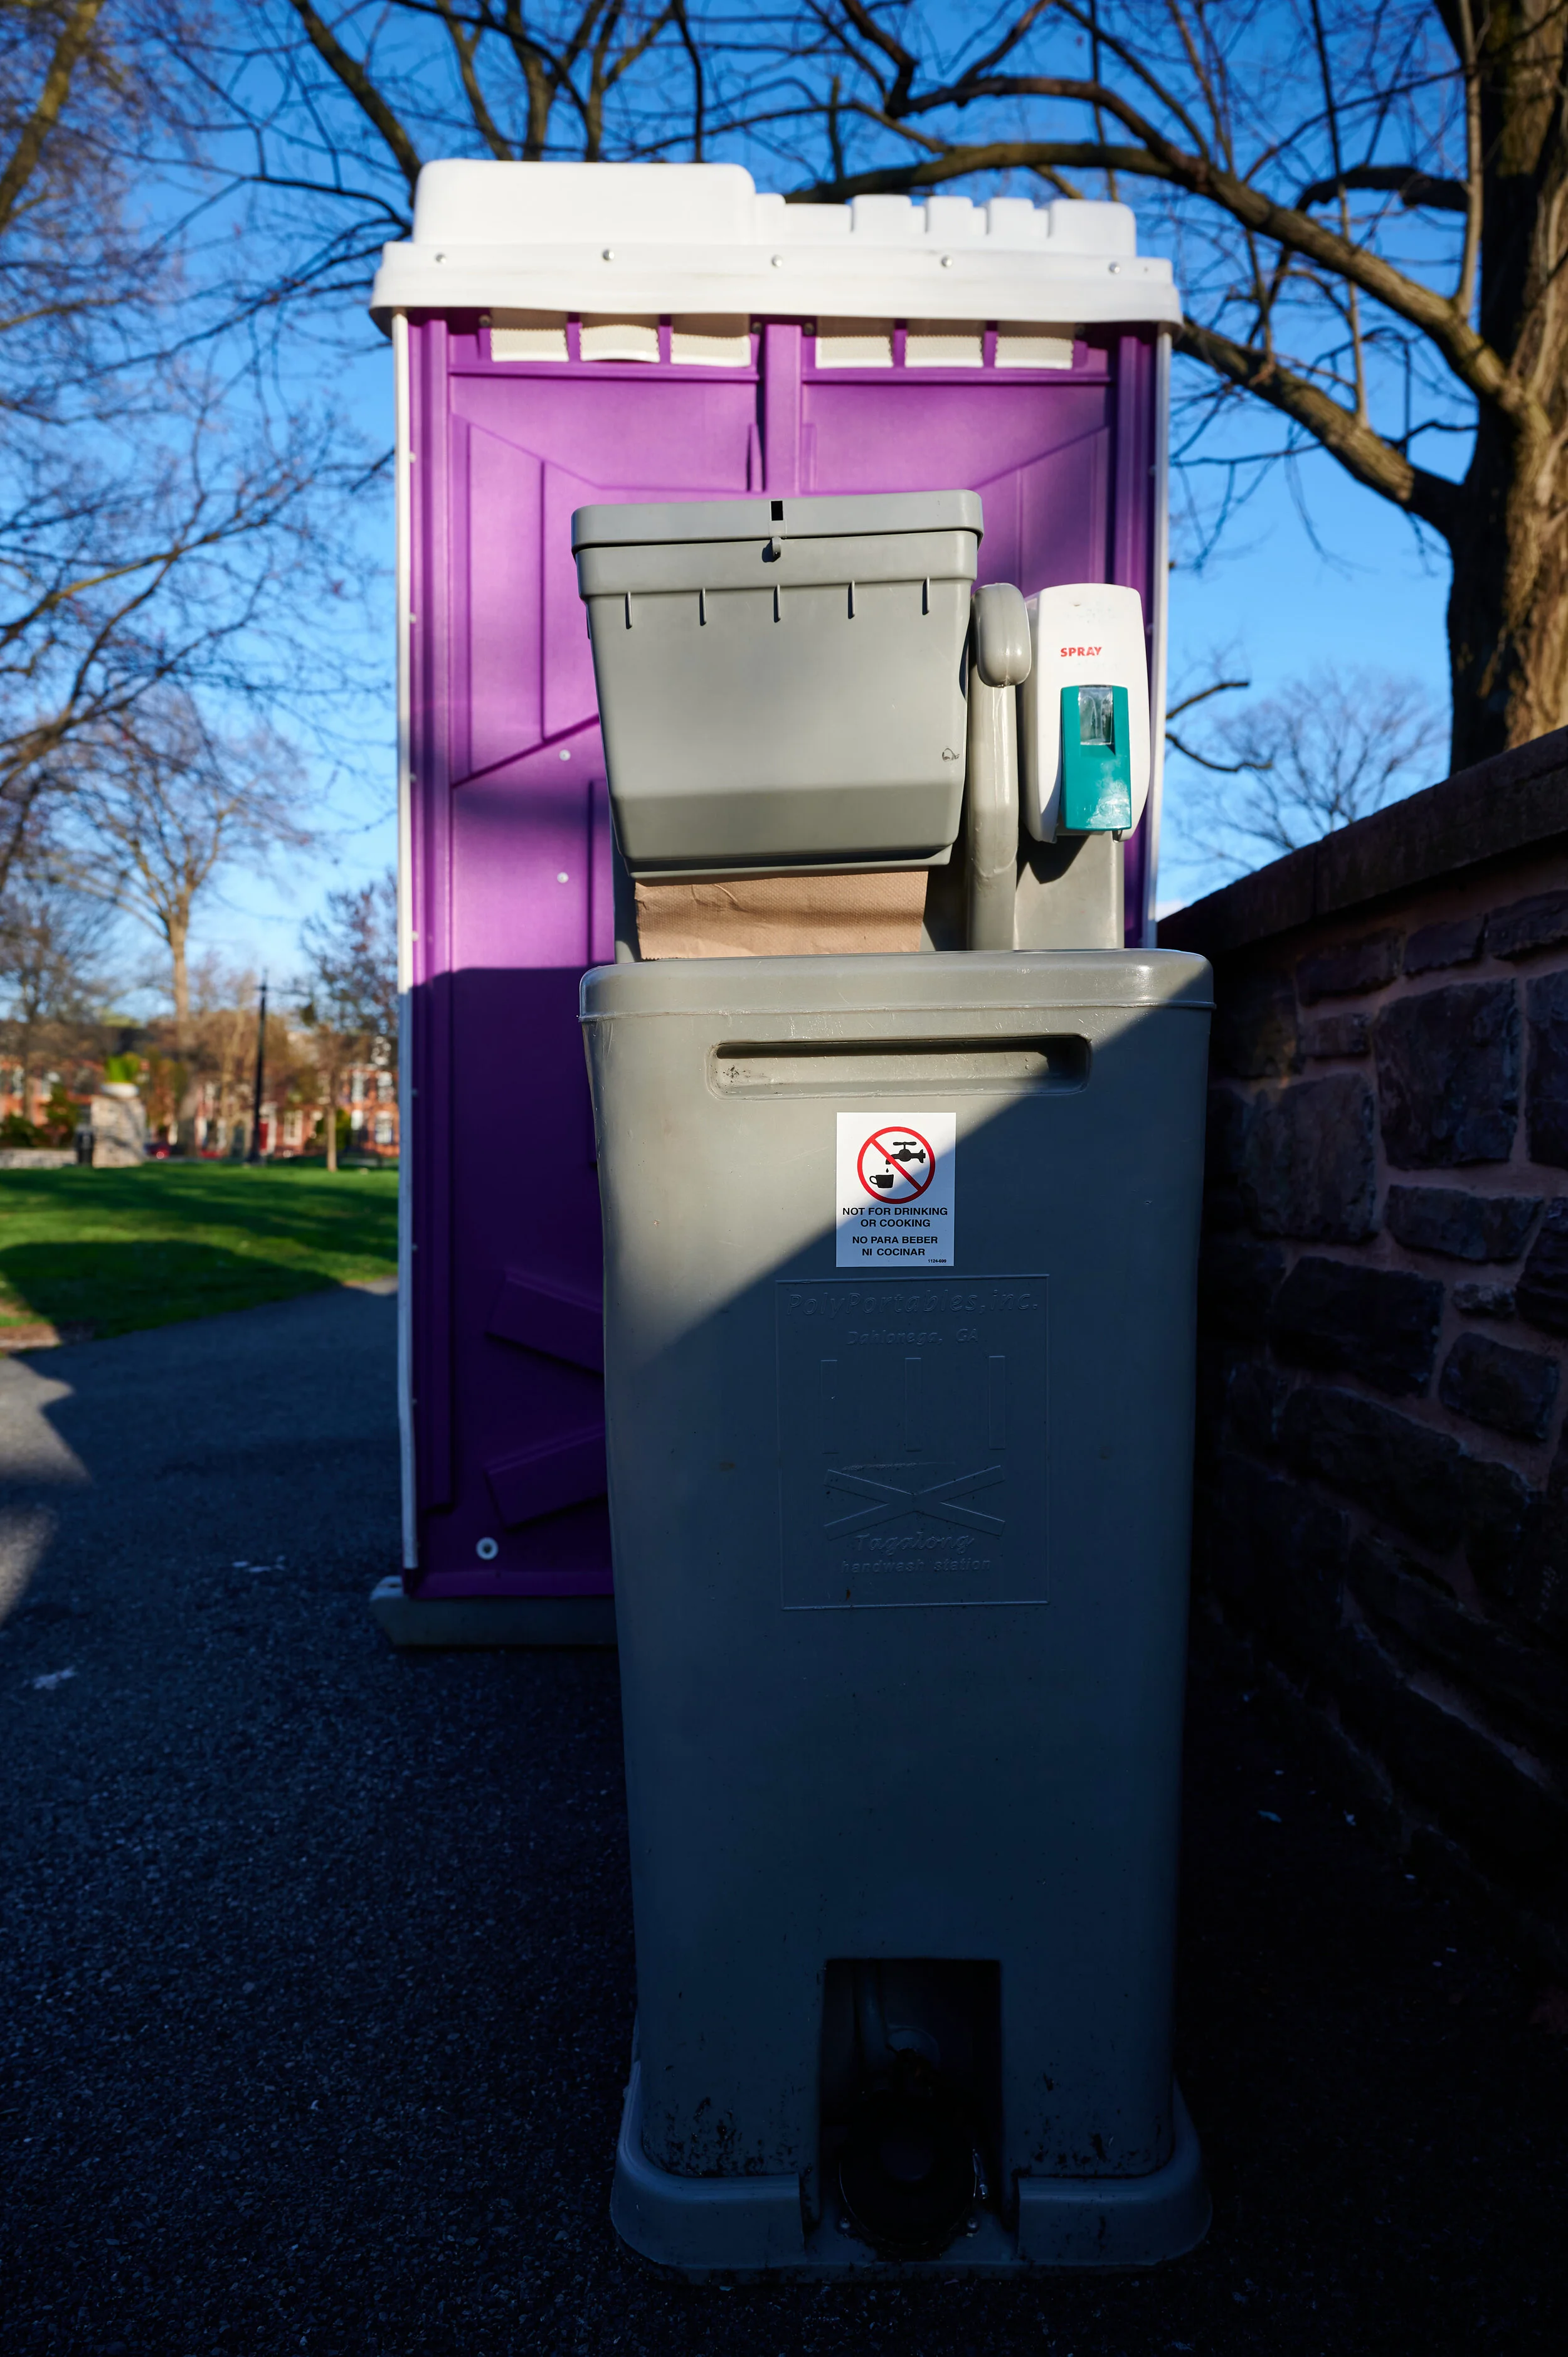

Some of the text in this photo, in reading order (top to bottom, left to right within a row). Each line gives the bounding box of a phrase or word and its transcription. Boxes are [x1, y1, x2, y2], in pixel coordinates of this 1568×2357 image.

[1061, 647, 1102, 657] SPRAY
[842, 1207, 948, 1216] NOT FOR DRINKING
[861, 1219, 931, 1227] OR COOKING
[876, 1248, 925, 1256] COCINAR
[955, 1327, 978, 1344] GA
[854, 1531, 975, 1556] Tagalong
[841, 1558, 992, 1573] handwash station
